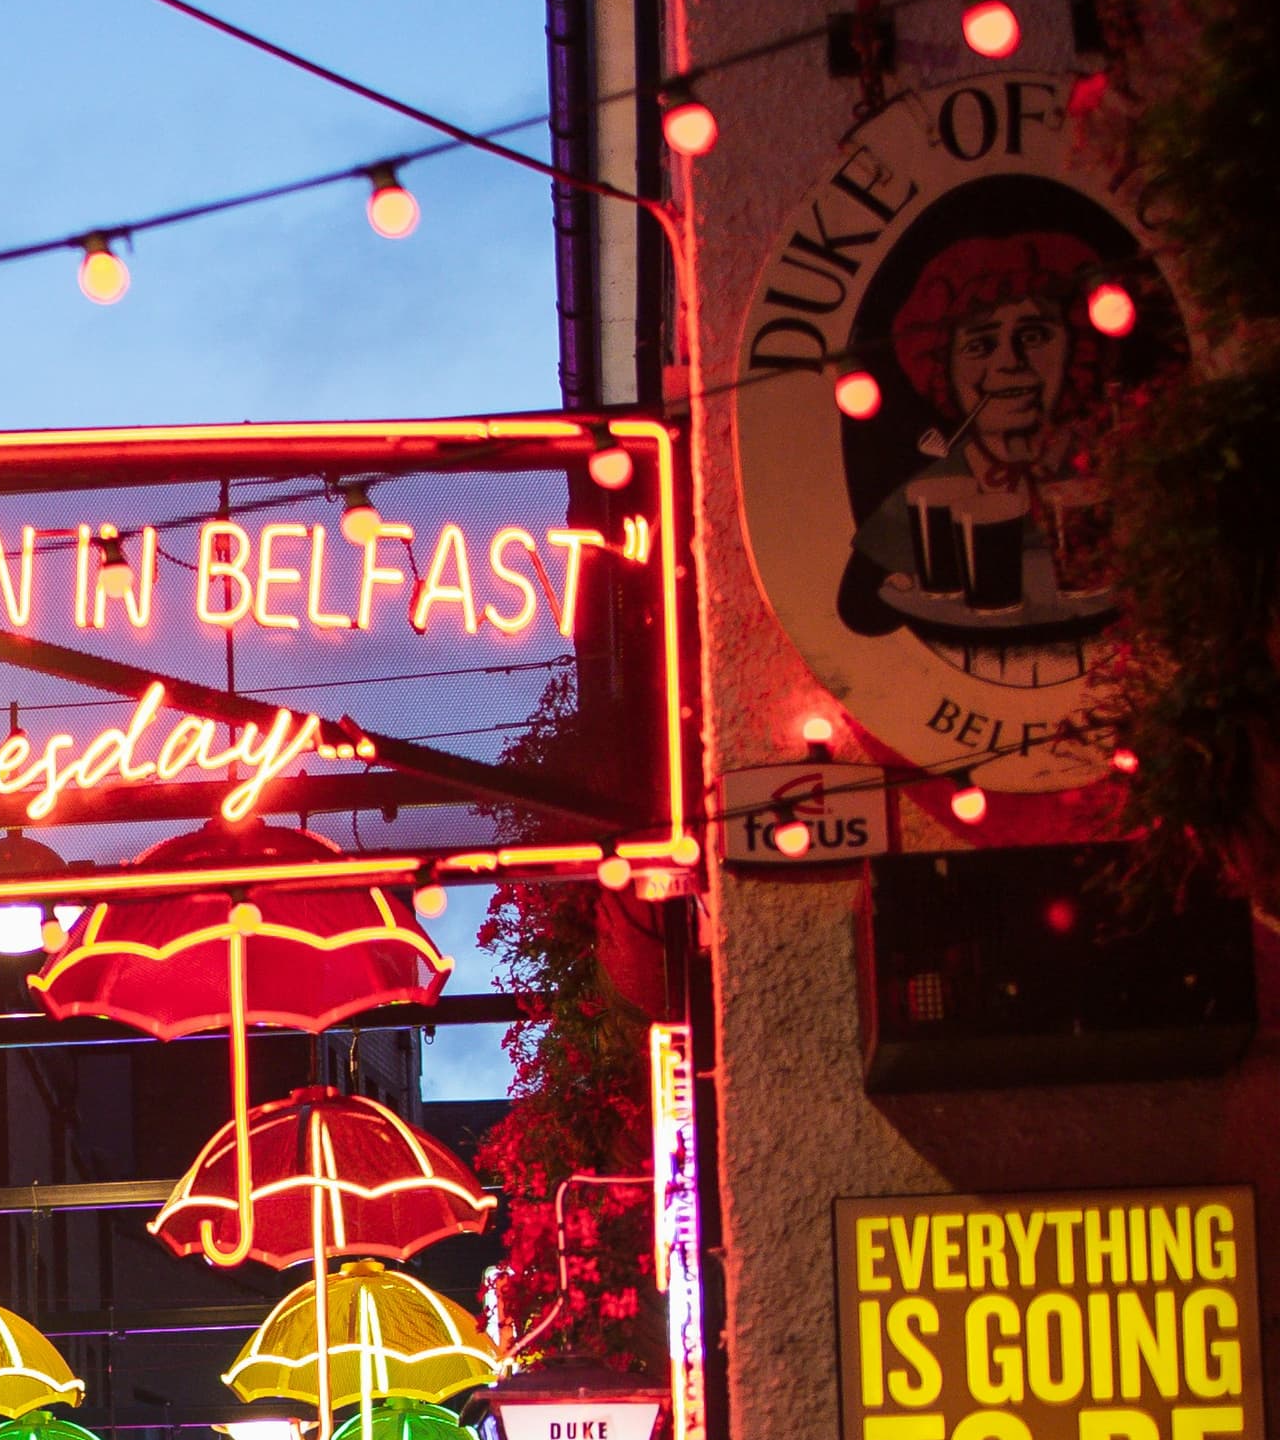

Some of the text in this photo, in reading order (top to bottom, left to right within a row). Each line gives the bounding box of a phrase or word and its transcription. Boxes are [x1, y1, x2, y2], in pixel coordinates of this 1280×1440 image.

[938, 81, 1062, 161] OF
[749, 145, 919, 375] DUKE
[74, 522, 154, 630] IN
[856, 1204, 1236, 1295] EVERYTHING
[860, 1288, 1241, 1408] IS GOING
[550, 1422, 609, 1440] DUKE
